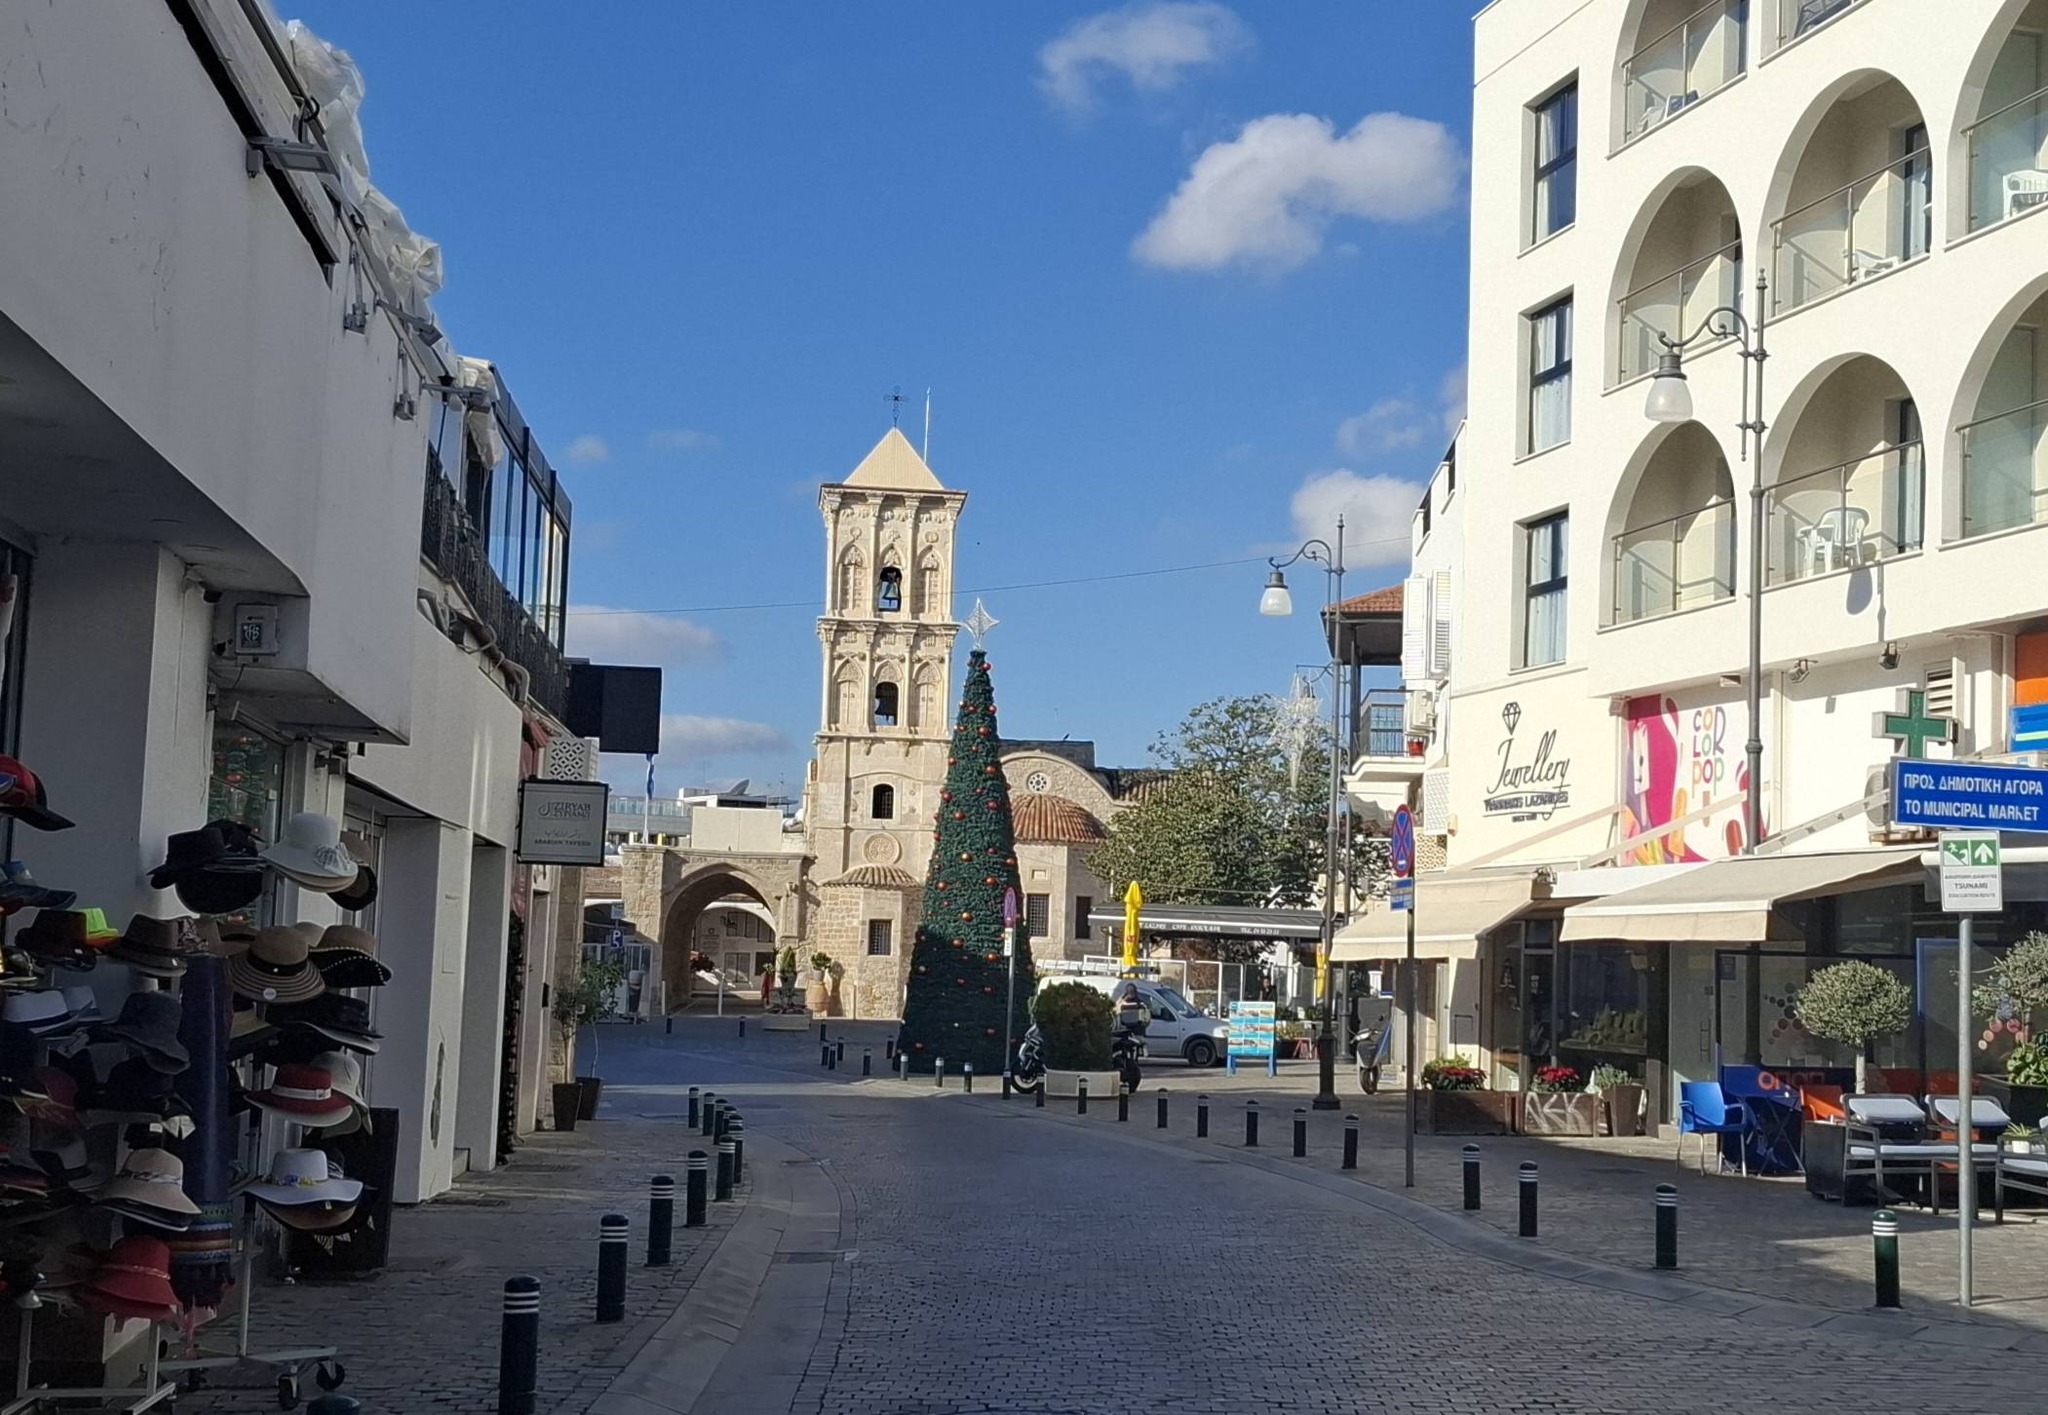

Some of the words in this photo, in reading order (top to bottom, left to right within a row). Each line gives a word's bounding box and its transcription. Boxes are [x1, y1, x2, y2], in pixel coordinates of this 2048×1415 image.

[1486, 729, 1571, 821] Jewellery
[1904, 773, 1936, 790] ΠΡΟΣ
[1939, 776, 2001, 794] ΔΗΜΟΤΙΚΗ
[2004, 780, 2044, 796] ΑΓΟΡΑ
[1904, 799, 1921, 815] TO
[1924, 801, 1986, 819] MUNICIPAL
[1989, 804, 2040, 821] MARKET
[1954, 882, 1988, 890] TSUNAMI
